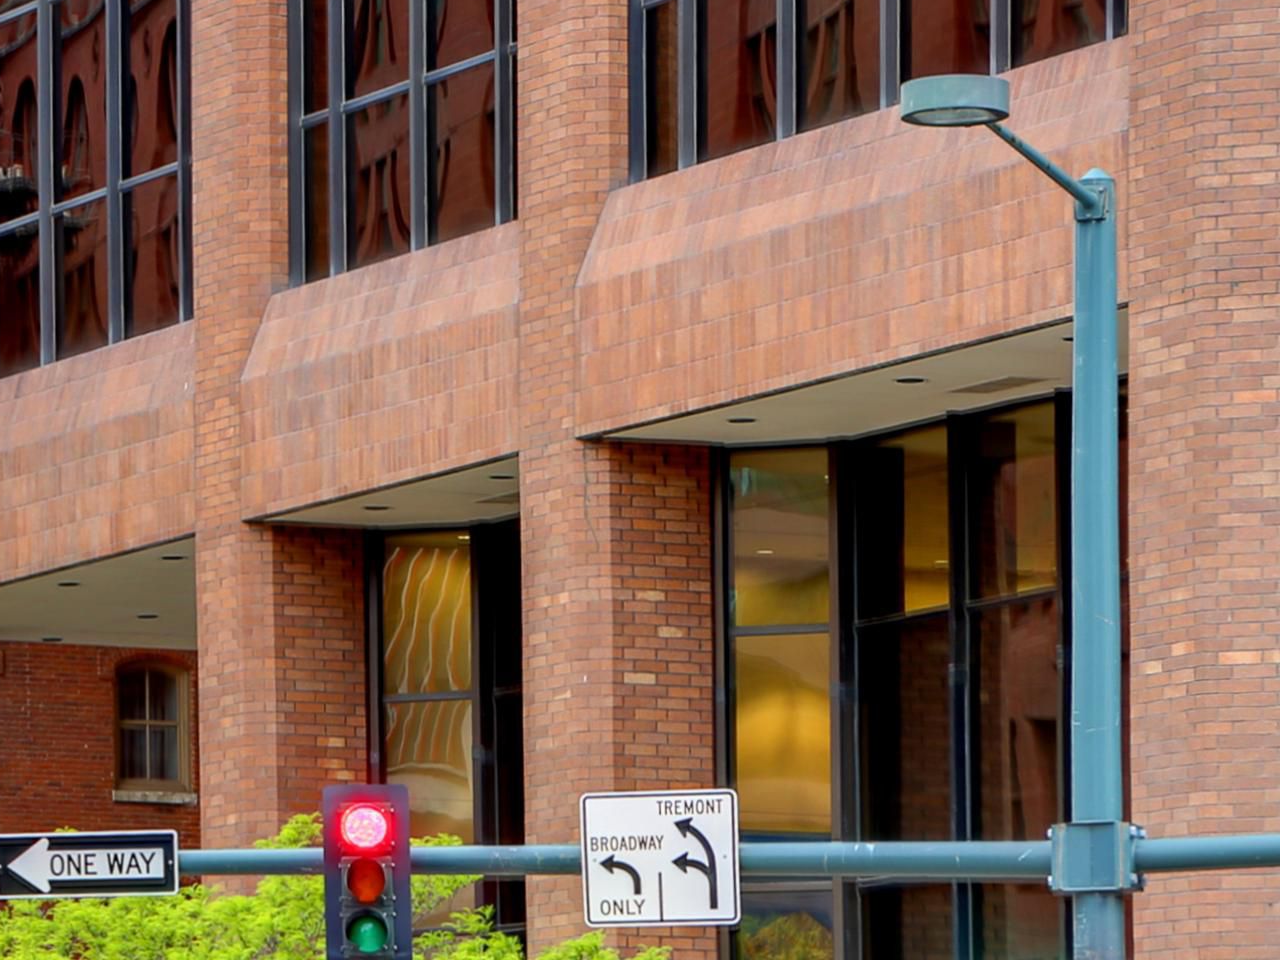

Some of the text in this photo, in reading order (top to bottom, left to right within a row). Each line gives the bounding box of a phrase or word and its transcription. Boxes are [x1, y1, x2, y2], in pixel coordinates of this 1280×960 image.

[656, 799, 723, 815] TREMONT
[590, 835, 664, 852] BROADWAY
[50, 852, 156, 876] ONE WAY
[600, 899, 645, 916] ONLY
